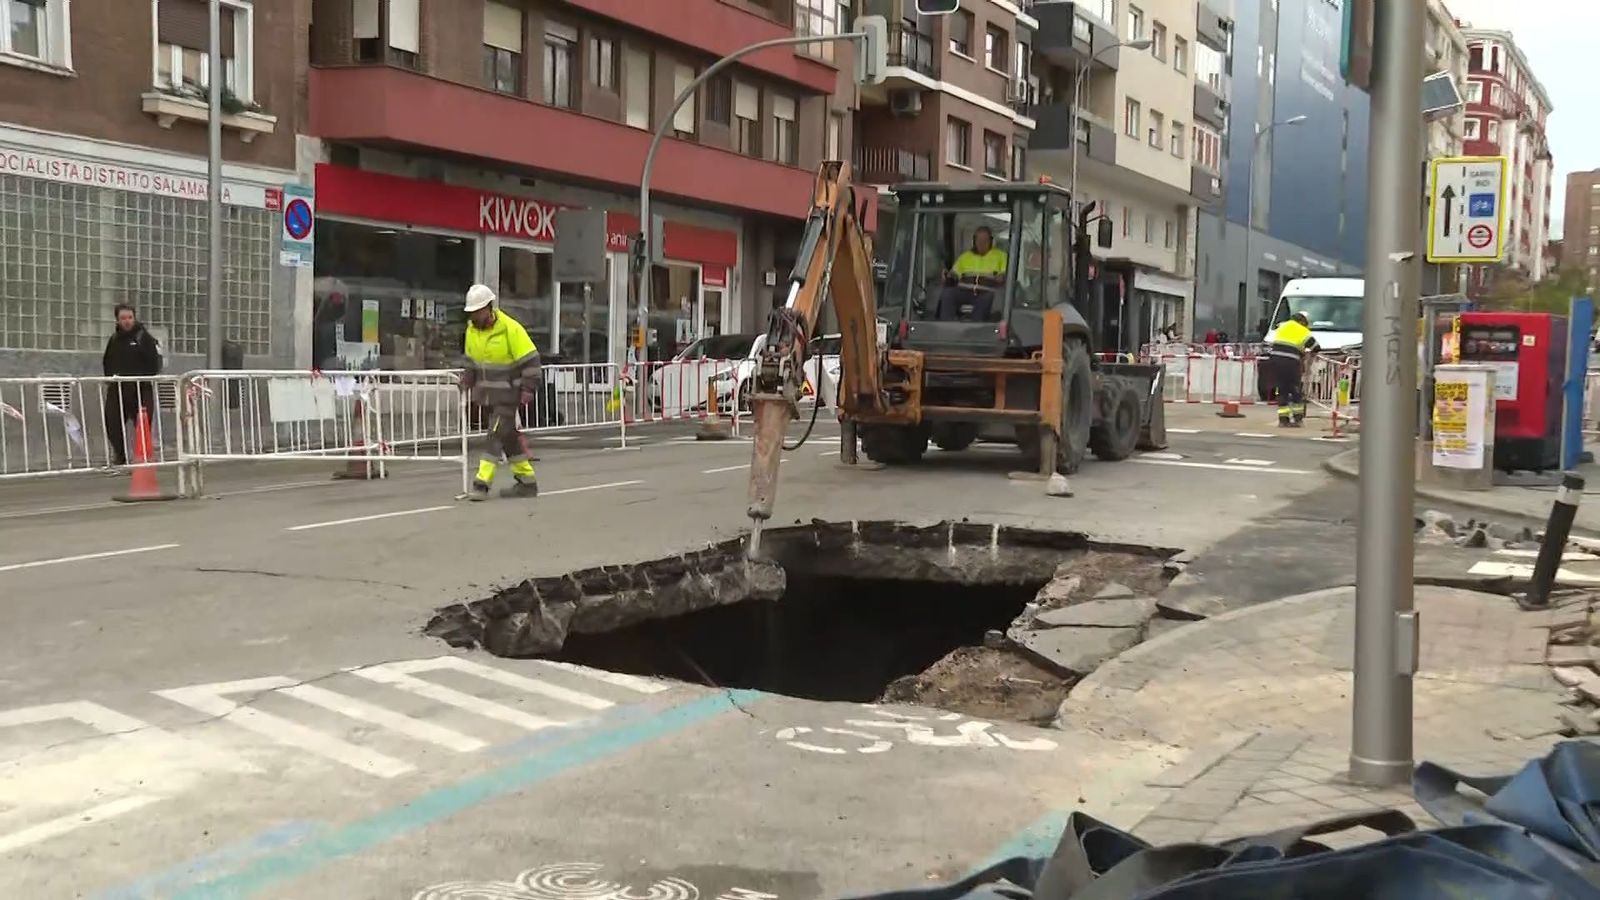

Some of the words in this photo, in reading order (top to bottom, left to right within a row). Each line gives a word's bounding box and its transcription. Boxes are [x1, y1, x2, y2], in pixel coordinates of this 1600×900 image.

[84, 166, 149, 189] DISTRITO
[153, 176, 230, 201] SALAMAA
[480, 195, 567, 239] KIWOK
